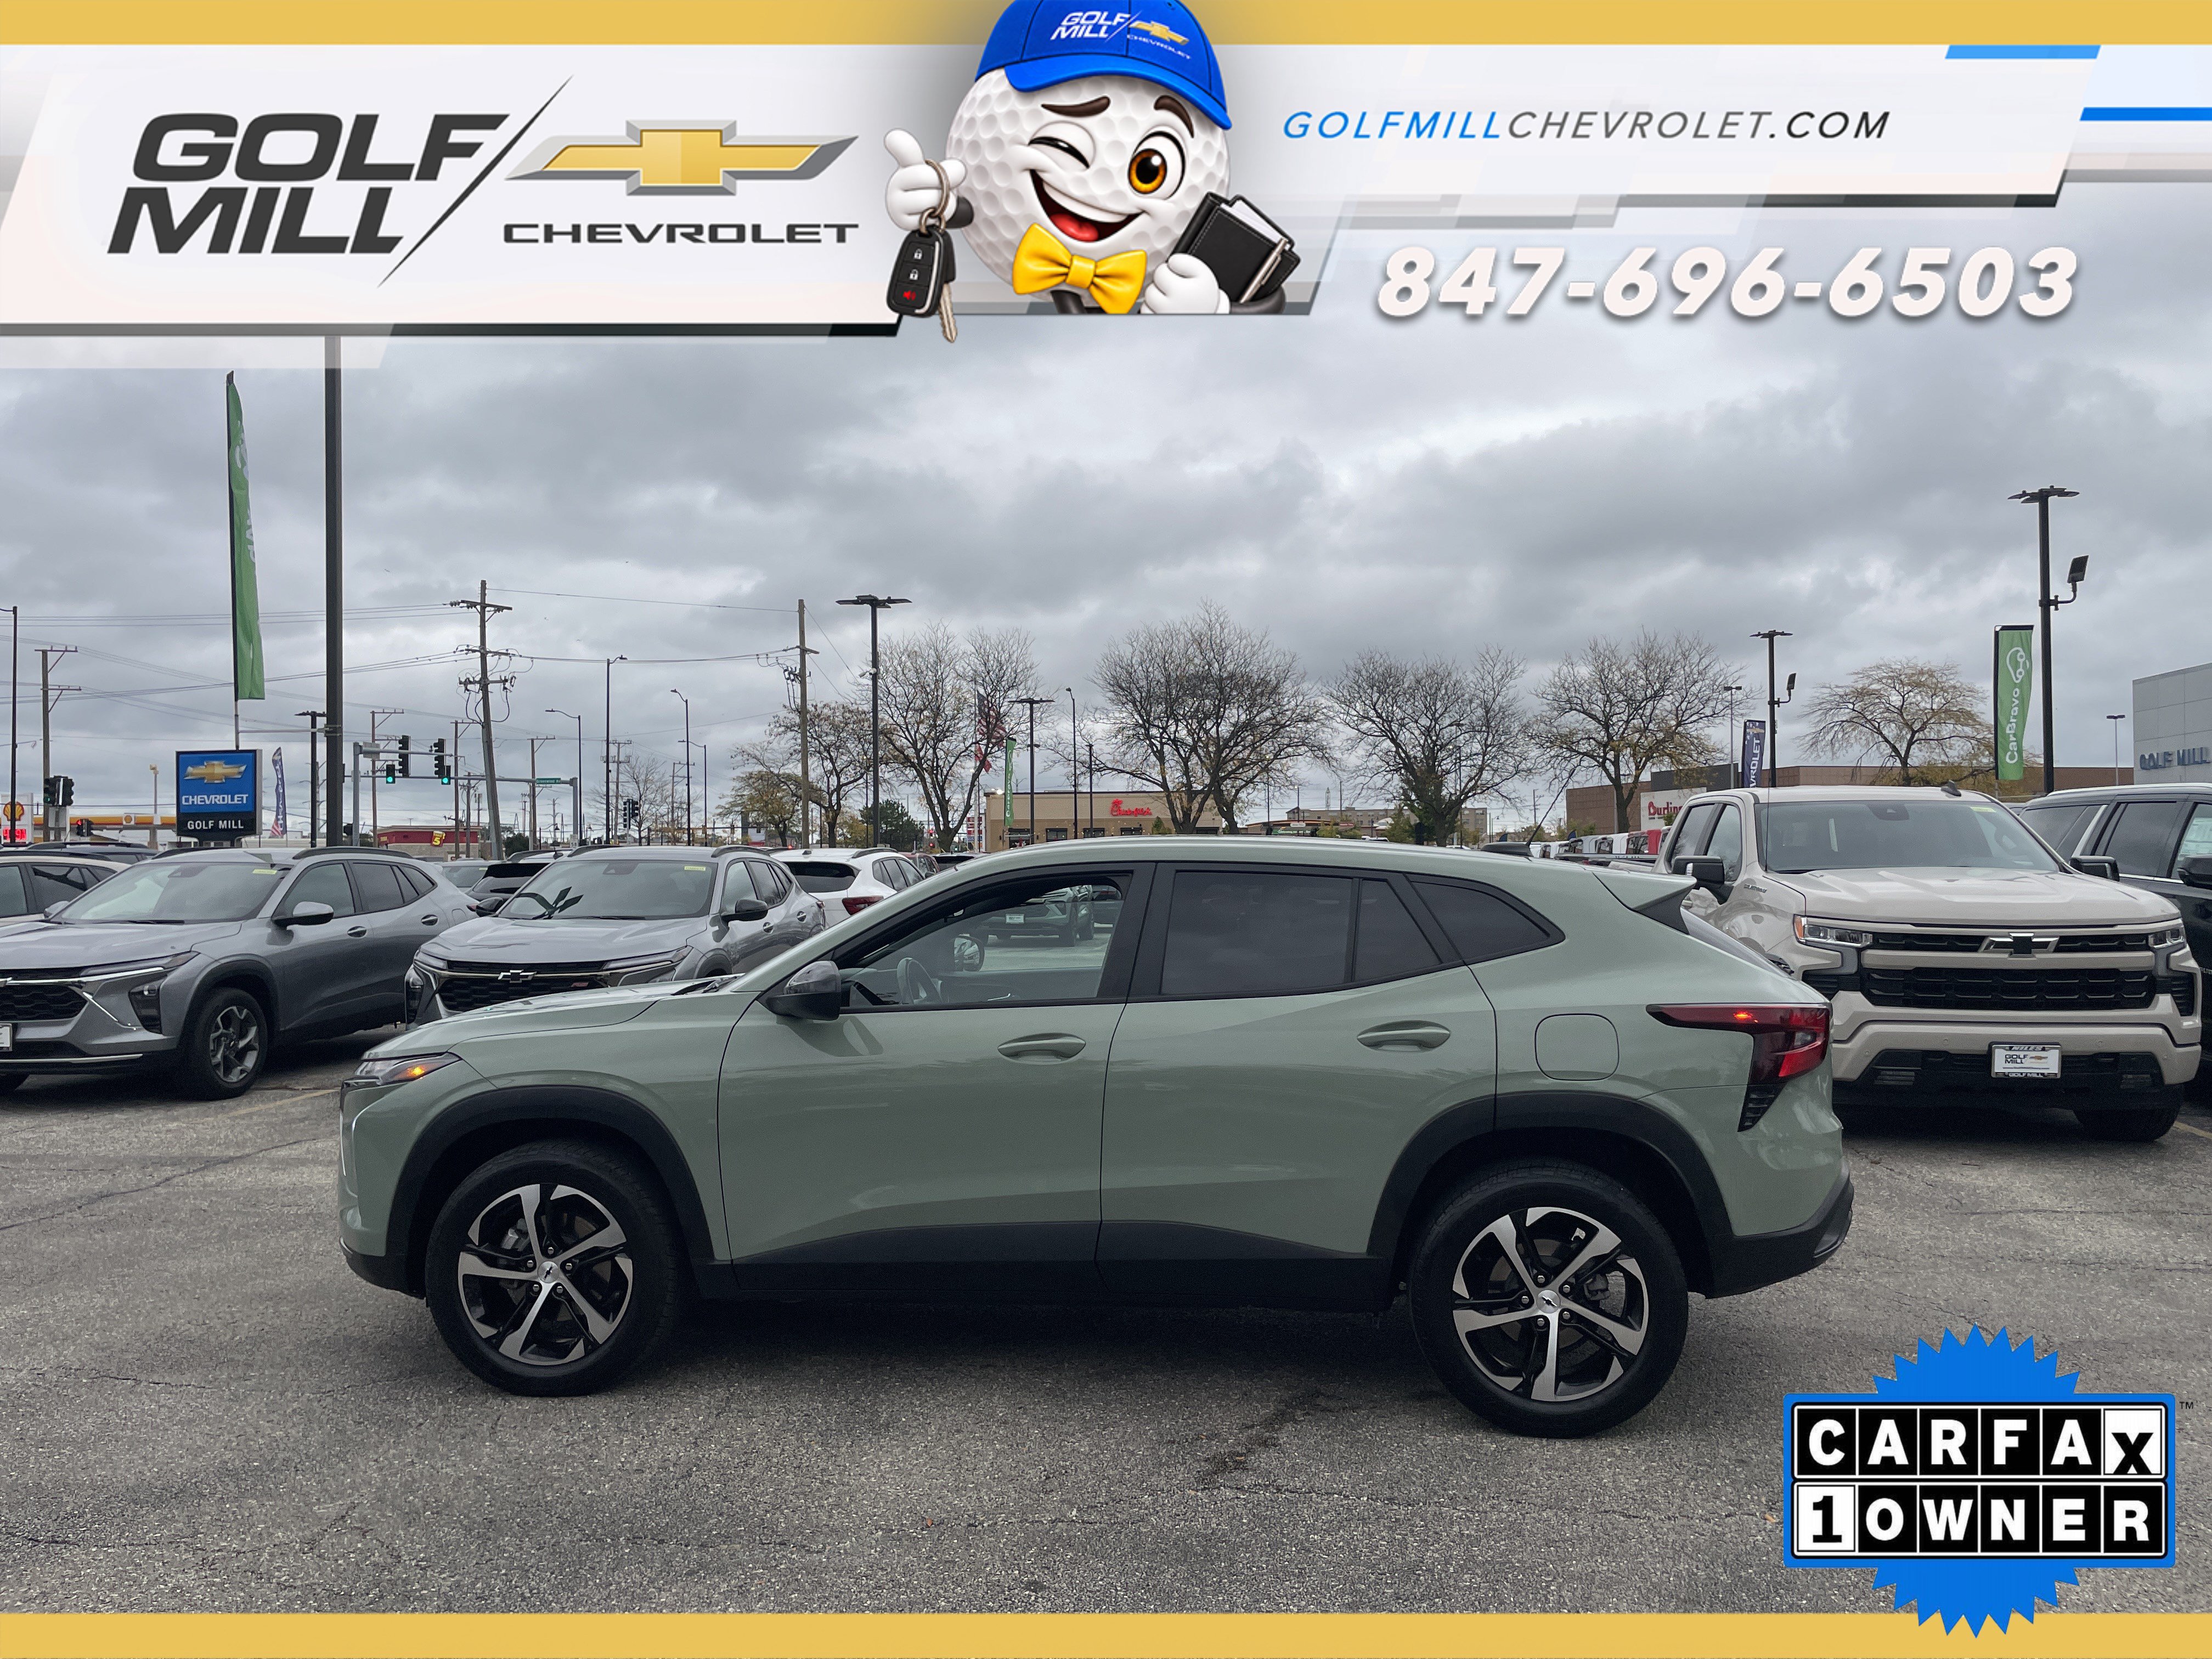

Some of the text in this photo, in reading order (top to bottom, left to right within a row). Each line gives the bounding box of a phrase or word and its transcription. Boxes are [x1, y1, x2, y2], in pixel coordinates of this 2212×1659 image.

[2006, 687, 2021, 764] CarBravo
[1749, 737, 1760, 788] VROLET
[182, 794, 249, 805] CHEVROLET
[187, 820, 244, 830] GOLF MILL
